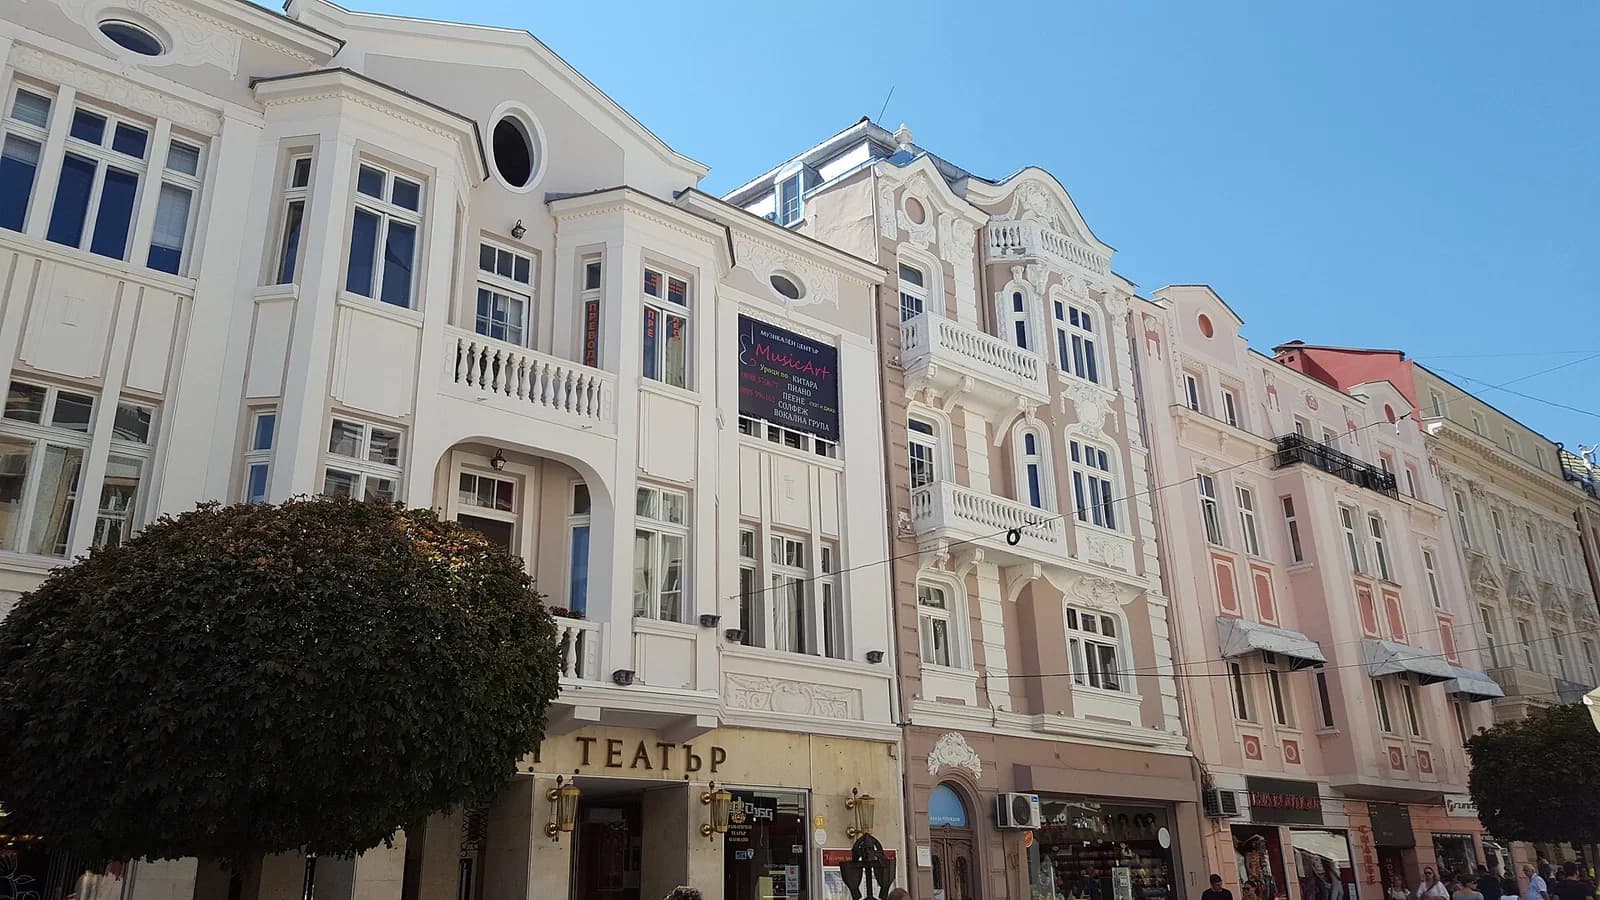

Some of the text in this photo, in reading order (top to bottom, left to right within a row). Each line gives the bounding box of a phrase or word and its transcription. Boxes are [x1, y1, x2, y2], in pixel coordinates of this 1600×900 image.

[760, 330, 796, 348] МУЗИКАЛЕН
[755, 343, 832, 380] MusicArt
[760, 364, 780, 378] Уроци
[787, 383, 812, 398] ПИАНО
[792, 375, 819, 391] КИТАРА
[782, 391, 806, 406] ПЕЕНЕ
[778, 400, 810, 416] СОЛФЕЖ
[774, 408, 831, 433] ВОКАЛНА ГРУПА
[576, 737, 727, 773] ТЕАТЪР
